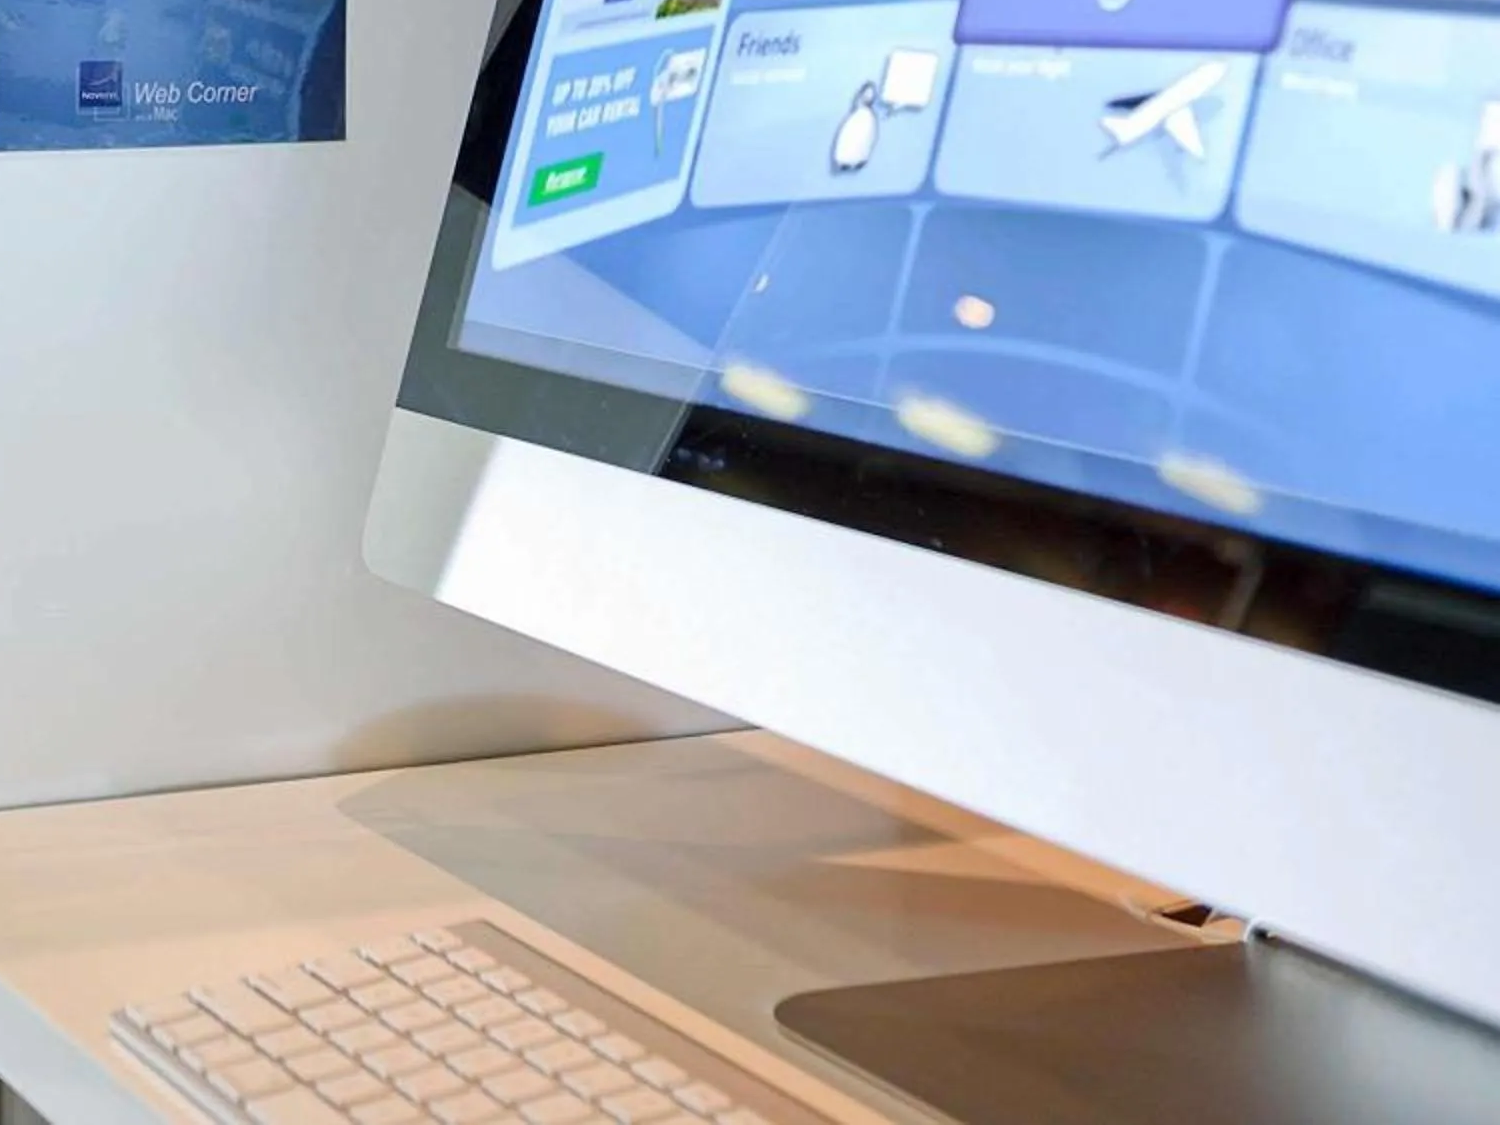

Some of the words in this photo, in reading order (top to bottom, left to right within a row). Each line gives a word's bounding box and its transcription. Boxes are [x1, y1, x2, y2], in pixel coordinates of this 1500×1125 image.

[736, 28, 802, 57] Friends
[133, 80, 182, 105] Web
[186, 79, 259, 104] Corner
[153, 106, 180, 123] Mac
